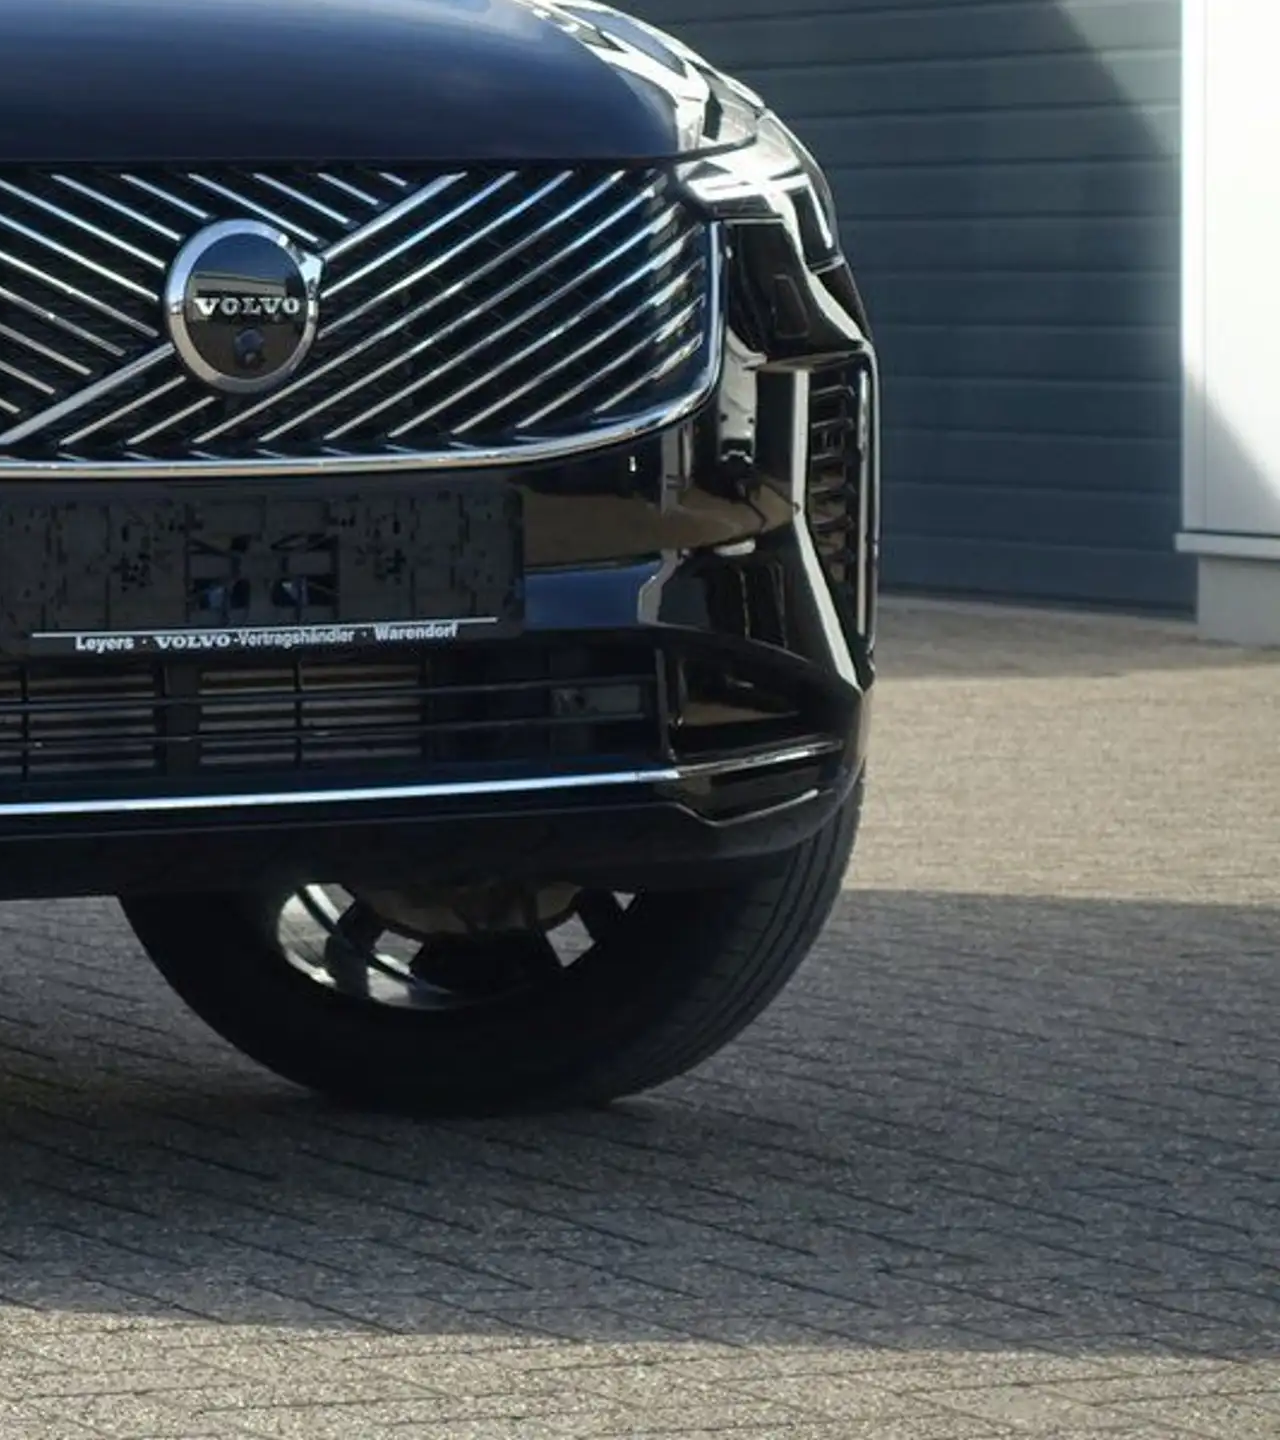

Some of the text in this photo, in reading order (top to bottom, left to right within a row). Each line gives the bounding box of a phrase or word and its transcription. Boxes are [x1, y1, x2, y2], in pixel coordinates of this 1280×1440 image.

[194, 296, 301, 317] VOLVO
[75, 635, 135, 654] Leyers
[373, 620, 458, 642] Warendorf
